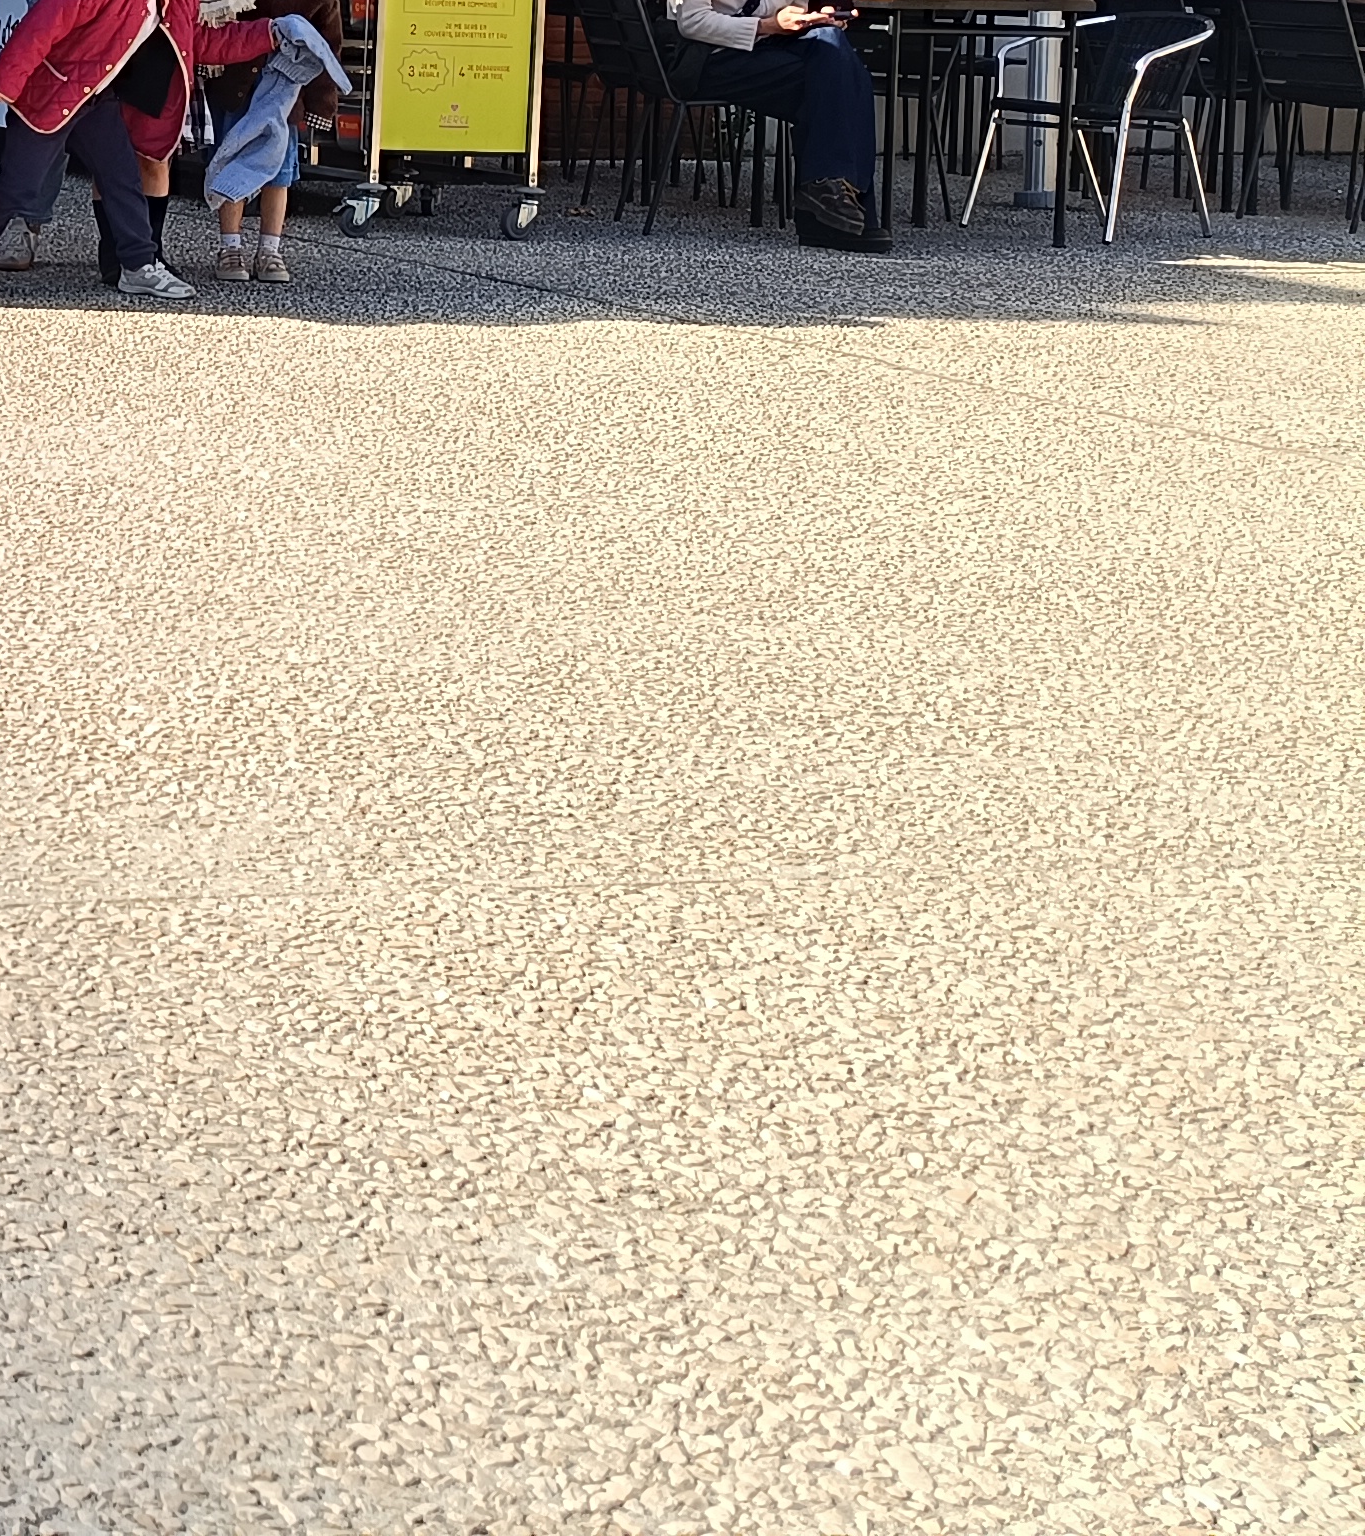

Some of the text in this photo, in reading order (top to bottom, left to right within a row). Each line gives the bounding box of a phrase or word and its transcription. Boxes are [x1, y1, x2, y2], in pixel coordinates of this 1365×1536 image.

[410, 24, 417, 35] 2
[408, 66, 415, 77] 3
[459, 66, 465, 77] 4
[439, 114, 469, 125] MERCI
